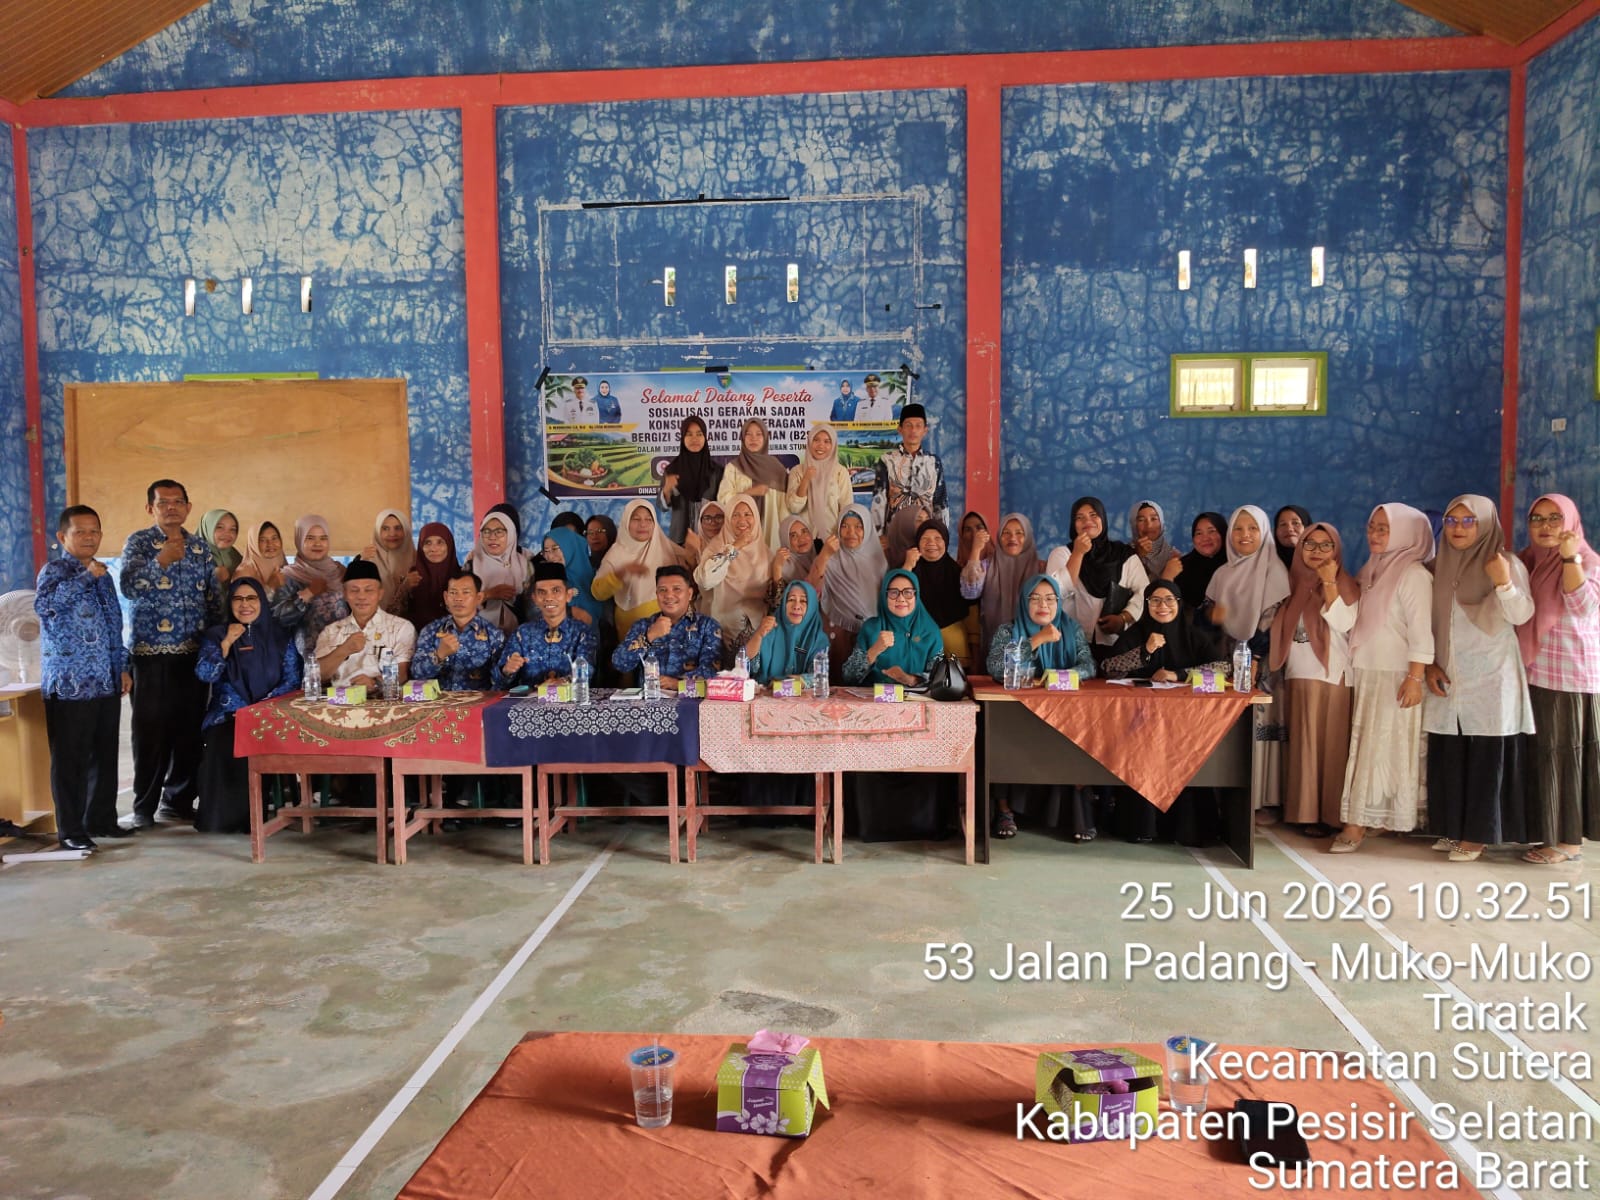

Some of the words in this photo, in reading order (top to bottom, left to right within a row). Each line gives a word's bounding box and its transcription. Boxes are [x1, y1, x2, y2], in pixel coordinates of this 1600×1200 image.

[641, 387, 701, 404] Selamat
[704, 387, 756, 407] Datang
[762, 387, 814, 404] Peserta
[648, 407, 714, 418] SOSIALISASI
[718, 406, 767, 417] GERAKAN
[770, 406, 806, 417] SADAR
[708, 419, 747, 430] PANGA
[631, 432, 671, 443] BERGIZI
